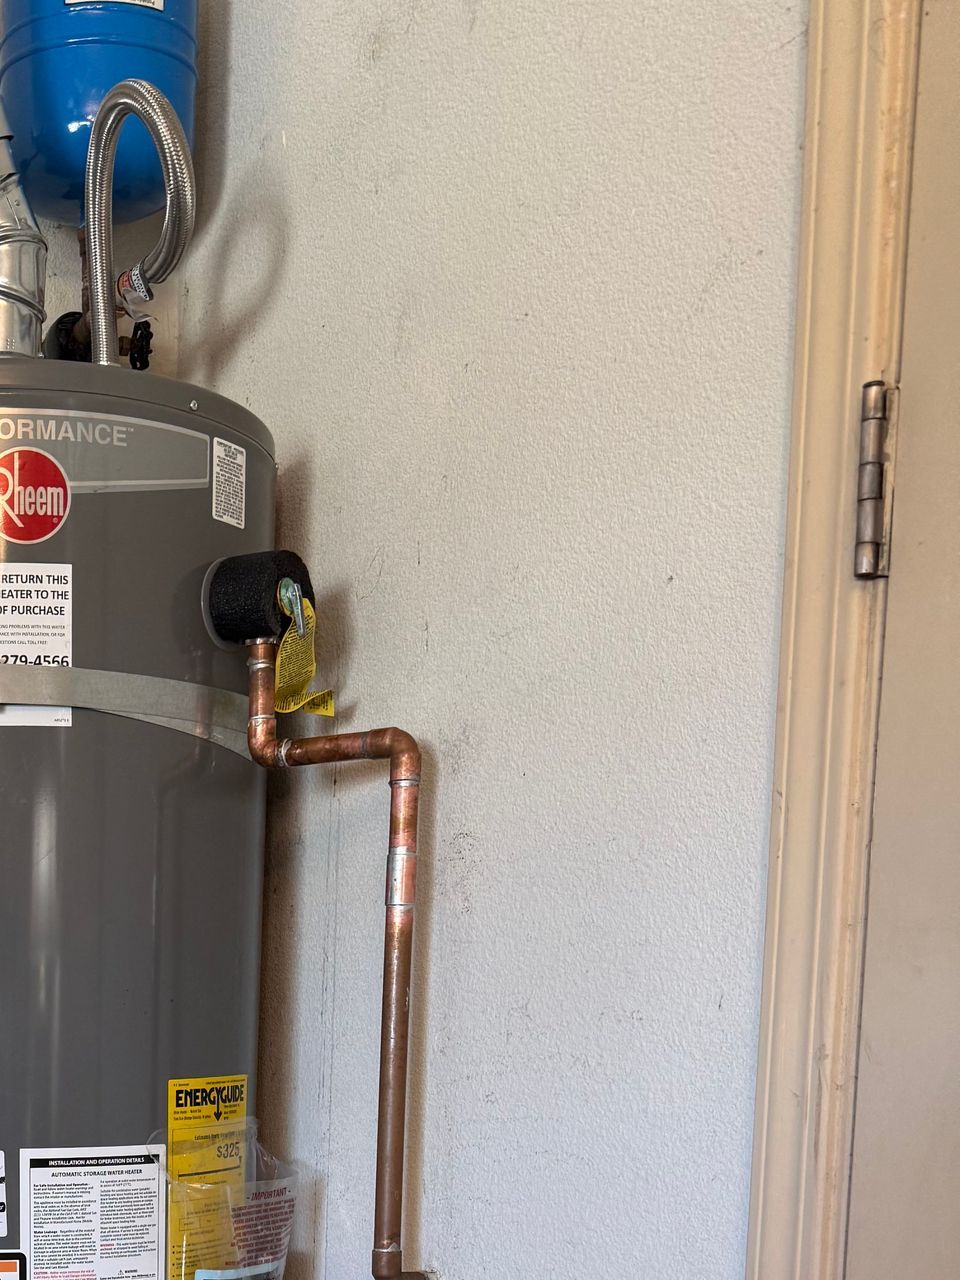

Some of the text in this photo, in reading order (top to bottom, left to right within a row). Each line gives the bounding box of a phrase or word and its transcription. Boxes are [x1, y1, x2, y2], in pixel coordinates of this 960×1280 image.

[2, 575, 43, 584] RETURN
[46, 575, 68, 584] THIS
[34, 590, 48, 599] TO
[51, 591, 69, 600] THE
[11, 606, 65, 616] PURCHASE
[176, 1084, 244, 1108] ENERGYGUIDE
[217, 1141, 240, 1158] $325
